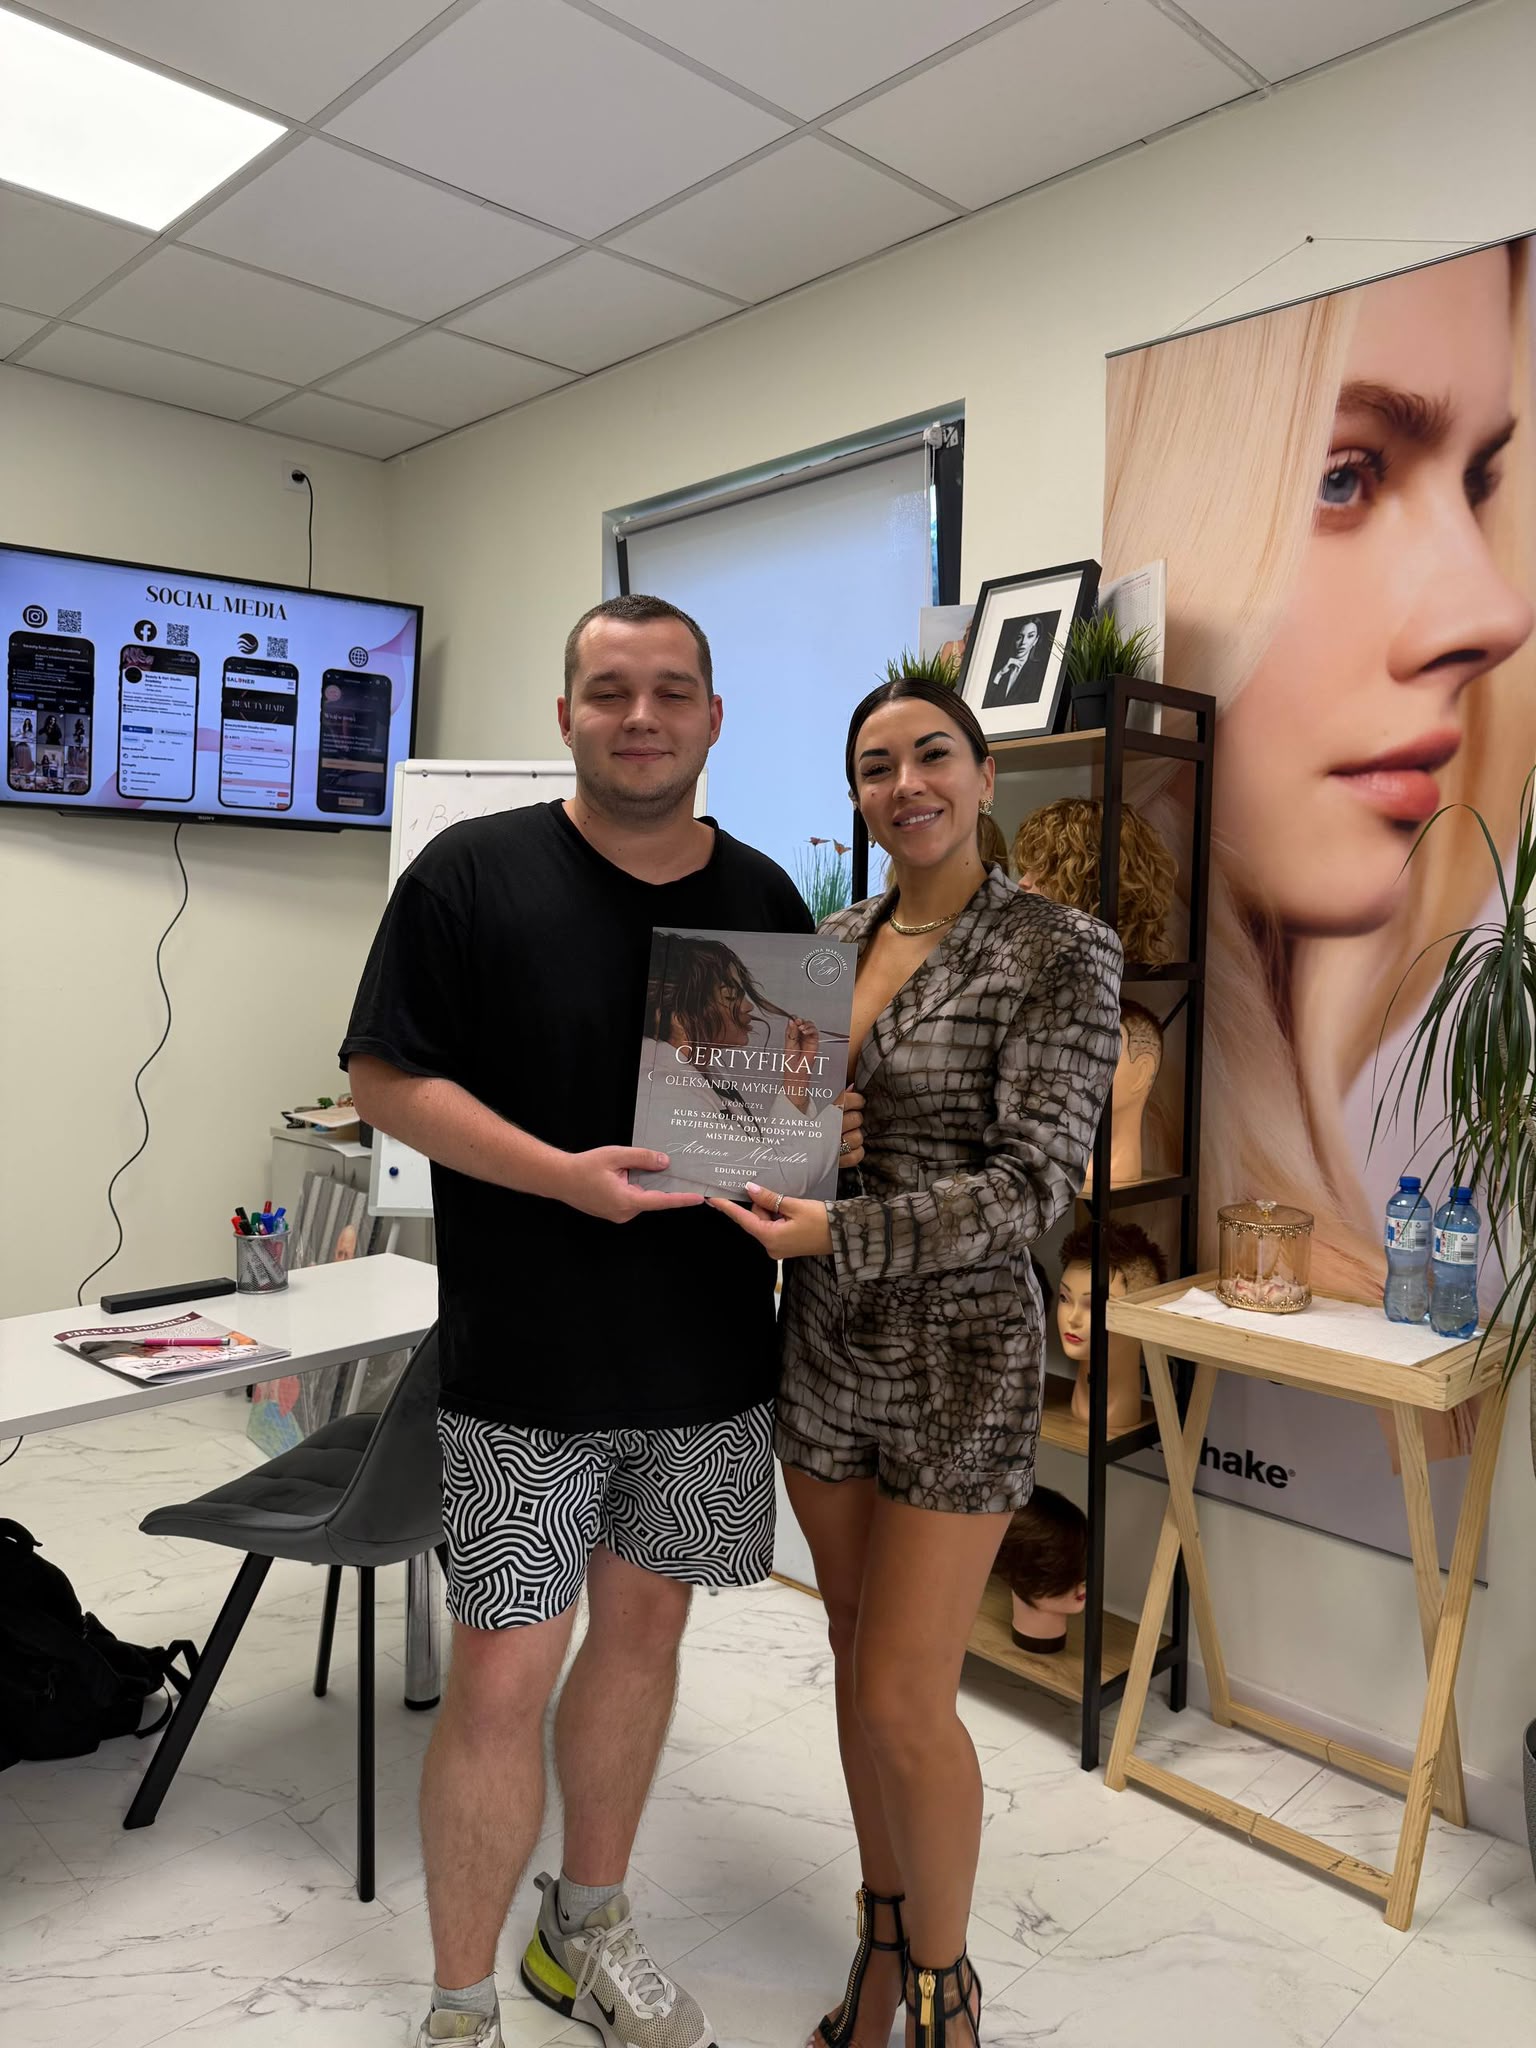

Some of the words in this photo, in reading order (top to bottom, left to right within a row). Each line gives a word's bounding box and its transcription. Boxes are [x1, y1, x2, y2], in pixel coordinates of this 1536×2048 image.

[146, 585, 219, 612] SOCIAL
[224, 596, 288, 621] MEDIA
[675, 1045, 830, 1076] CERTYFIKAT
[665, 1075, 738, 1092] OLEKSANDR
[741, 1082, 833, 1099] MYKHAILENKO
[670, 1118, 734, 1131] FRYZJERSTWA
[743, 1125, 758, 1133] OD
[760, 1127, 806, 1137] PODSTAW
[808, 1130, 823, 1139] DO
[673, 1108, 698, 1118] KURS
[700, 1110, 768, 1124] SZKOLENIOWY
[771, 1117, 777, 1125] Z
[779, 1118, 822, 1129] ZAKRESU
[714, 1167, 758, 1177] EDUKATOR
[718, 1180, 746, 1188] 28.07.20
[66, 1326, 131, 1338] EDUKACJA
[134, 1315, 192, 1331] PREMIUM
[1200, 1437, 1289, 1489] hake
